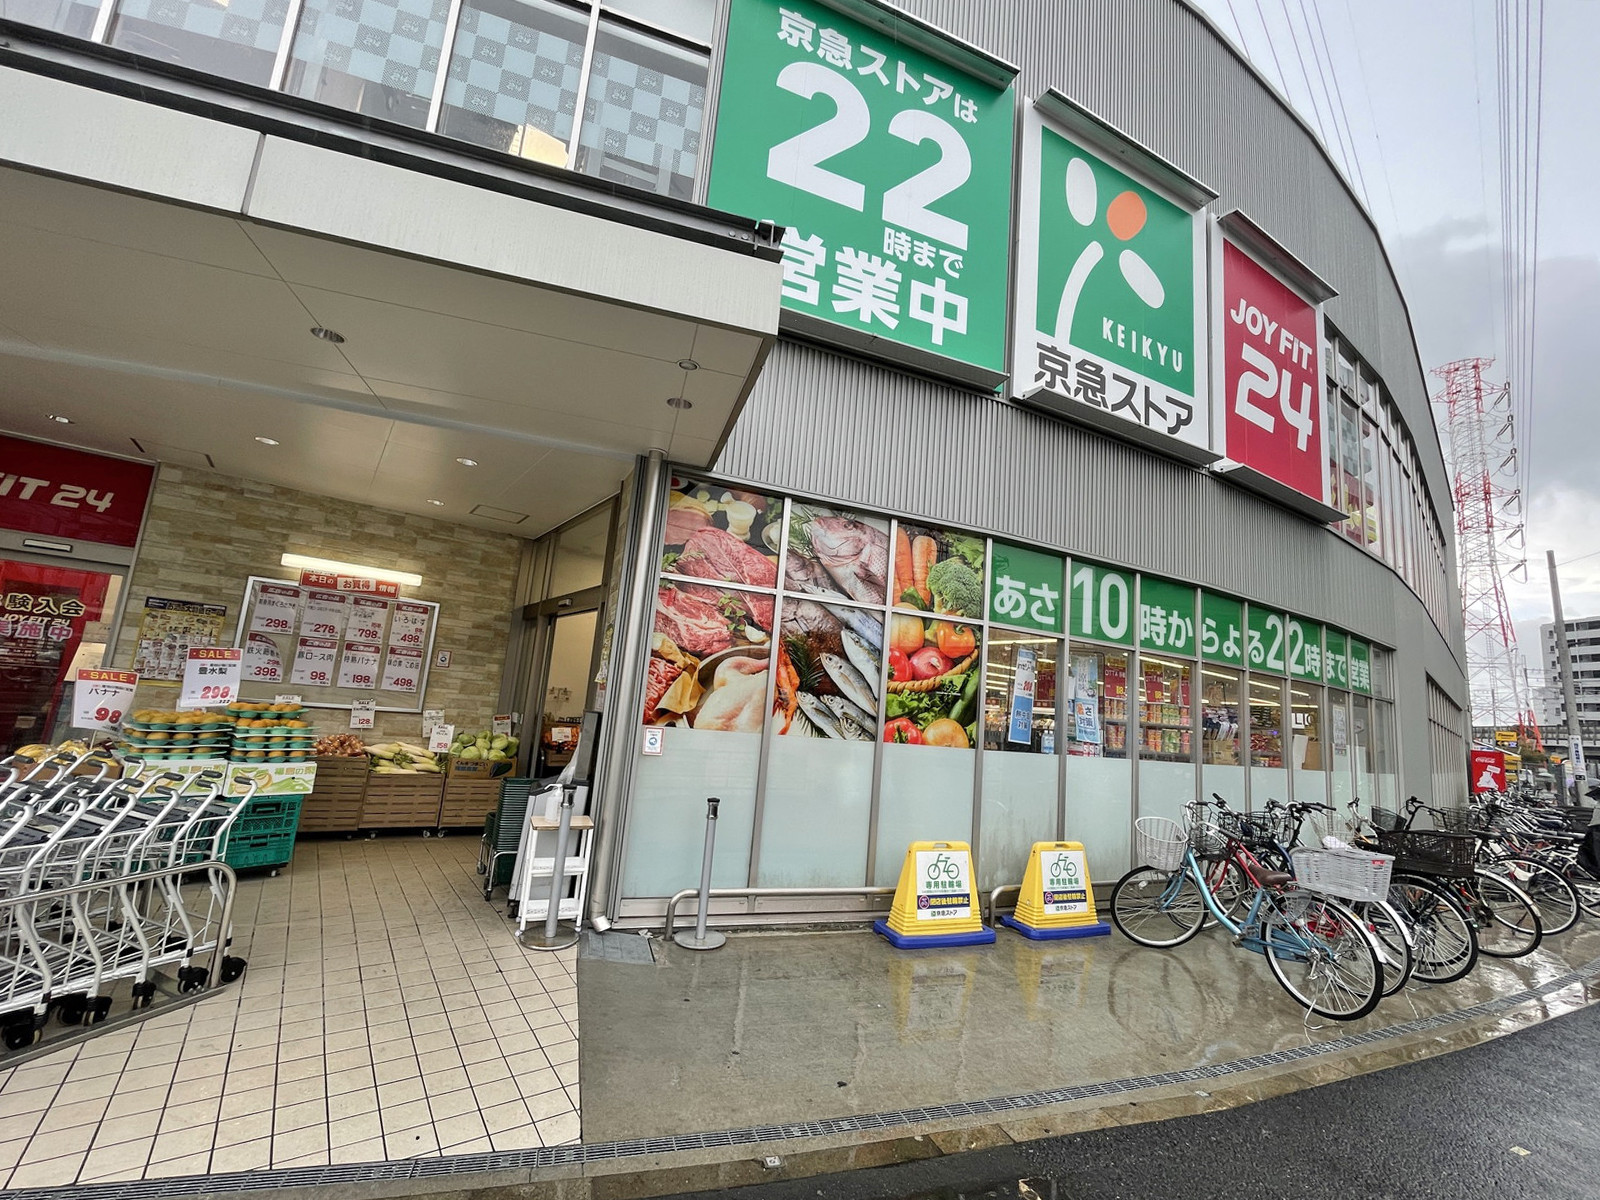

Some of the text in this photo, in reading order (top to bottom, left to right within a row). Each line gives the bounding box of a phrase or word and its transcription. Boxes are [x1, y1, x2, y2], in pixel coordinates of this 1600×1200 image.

[777, 7, 978, 124] 京急ストアは
[767, 61, 972, 251] 22
[883, 227, 964, 279] 時まで
[1102, 316, 1183, 373] KEIKYU
[1034, 341, 1194, 435] 京急ストア
[1235, 342, 1314, 452] 24
[0, 472, 115, 513] IT 24
[0, 593, 86, 616] 験入会
[265, 618, 288, 629] 298
[313, 624, 336, 634] 278
[358, 628, 378, 639] 798
[400, 634, 420, 643] 498
[199, 650, 232, 659] SALE
[90, 671, 128, 682] SALE
[198, 666, 228, 676] 豊水梨
[253, 666, 277, 677] 398
[310, 671, 326, 681] 98
[352, 674, 371, 684] 198
[393, 677, 413, 688] 498
[88, 687, 121, 698] バナナ
[94, 707, 122, 724] 98
